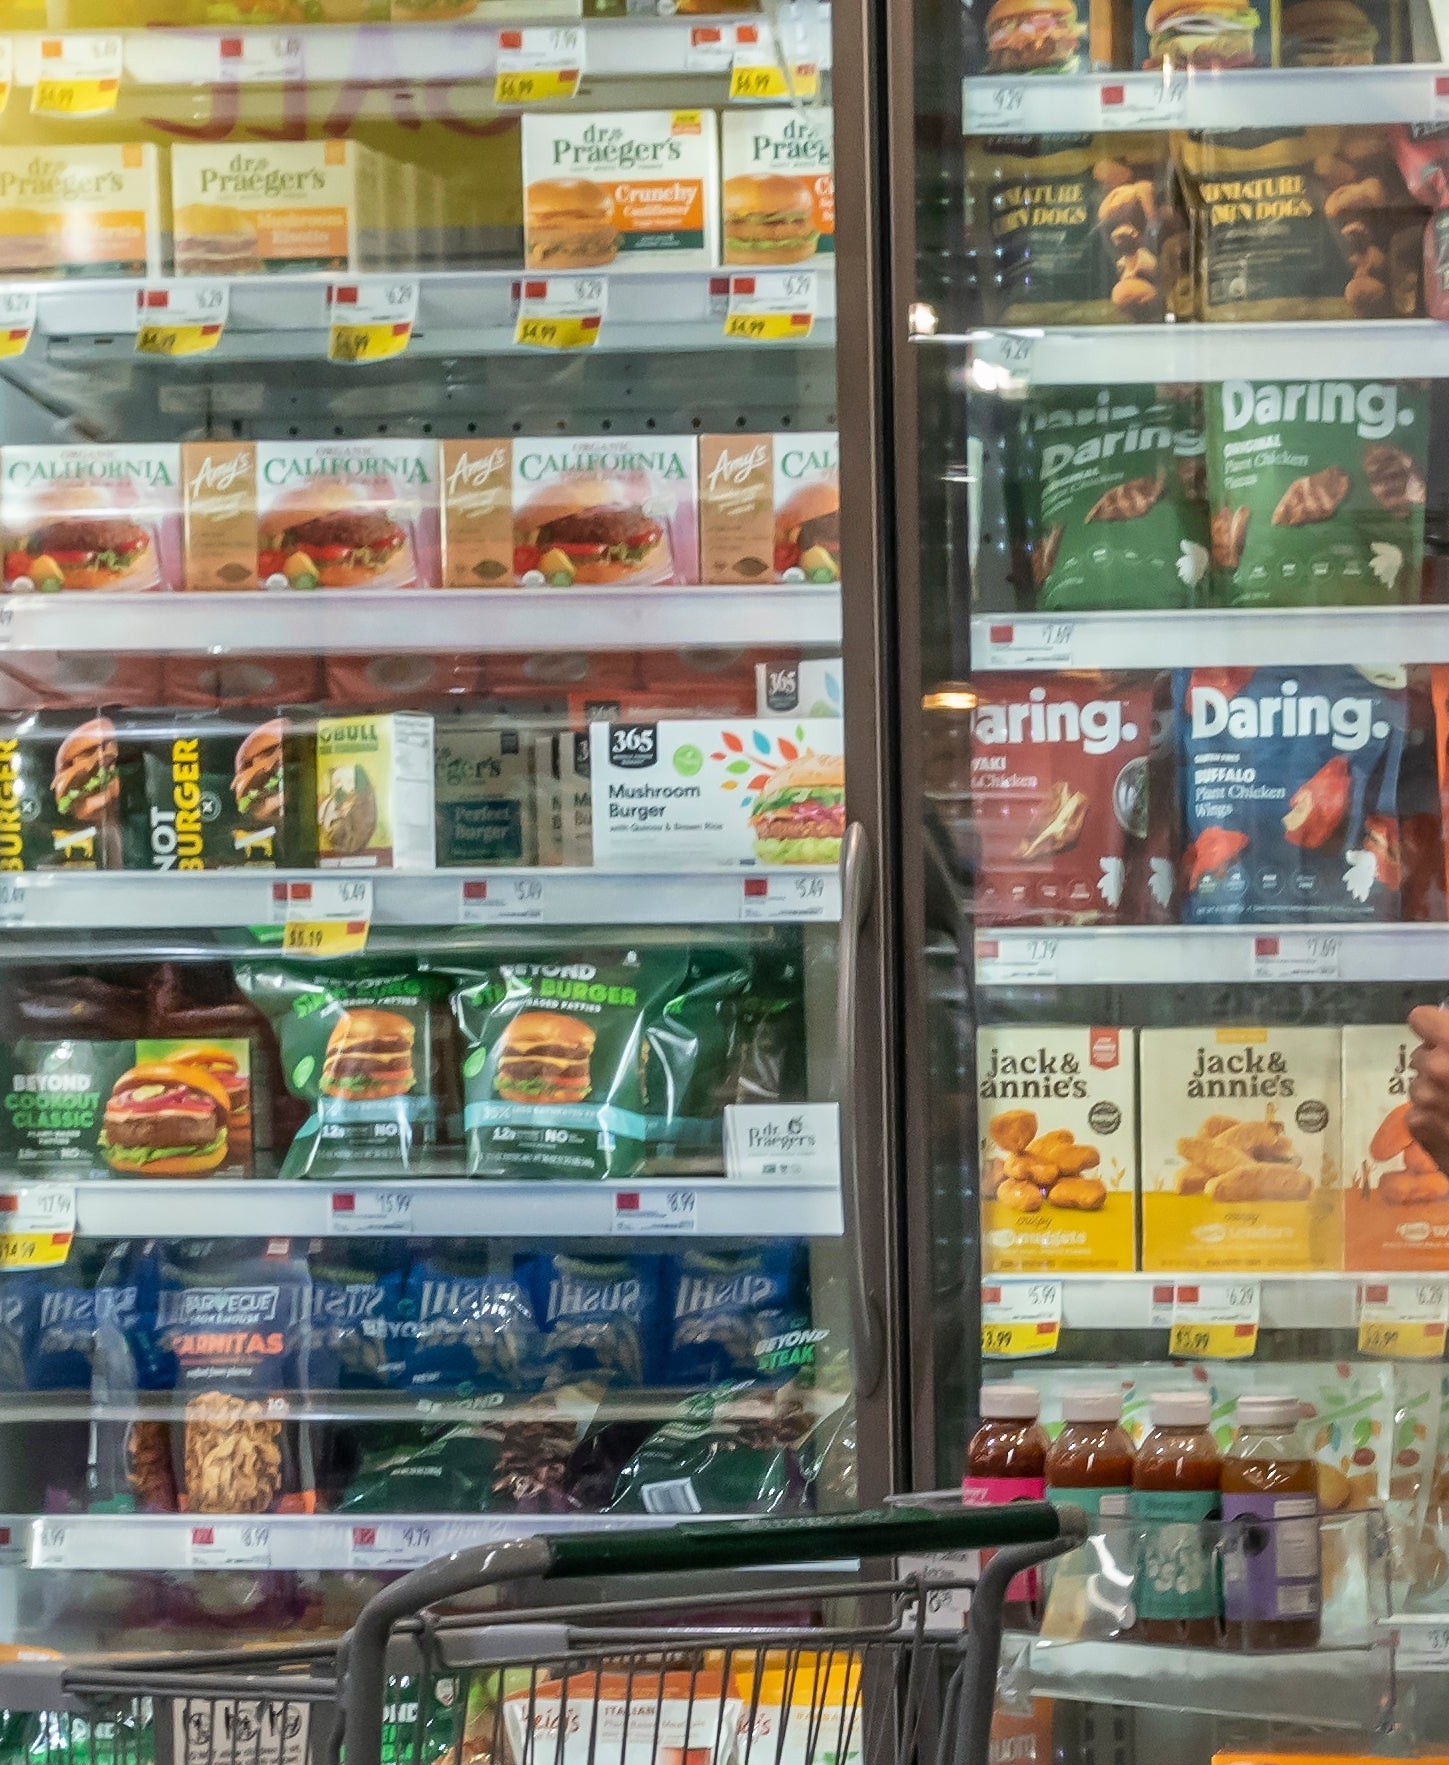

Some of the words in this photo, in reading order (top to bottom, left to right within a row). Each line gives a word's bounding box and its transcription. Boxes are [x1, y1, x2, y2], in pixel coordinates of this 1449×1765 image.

[553, 137, 681, 169] Praeger's
[0, 169, 124, 201] Praeger's
[200, 168, 325, 201] Praeger's
[615, 182, 698, 205] Crunchy
[8, 461, 173, 487] CALIFORNIA
[189, 451, 251, 497] Amy's
[263, 457, 428, 485] CALIFORNIA
[446, 446, 508, 492] Amy's
[519, 453, 688, 482] CALIFORNIA
[707, 443, 769, 489] Amy's
[972, 686, 1140, 755] aring.
[1190, 679, 1392, 751] Daring.
[612, 728, 654, 755] 365
[1194, 766, 1257, 786] BUFFALO
[172, 737, 205, 873] BURGER
[608, 785, 701, 799] Mushroom
[1195, 786, 1226, 802] Plant
[1228, 784, 1287, 800] Chicken
[608, 802, 666, 819] Burger
[1195, 802, 1234, 820] Wings
[152, 806, 176, 872] NOT
[539, 978, 637, 1007] BURGER
[986, 1047, 1083, 1077] jack&
[1192, 1046, 1289, 1077] jack&
[13, 1074, 91, 1091] BEYOND
[979, 1071, 1090, 1100] annie's
[1186, 1070, 1298, 1100] annie's
[5, 1093, 99, 1110] COOKOUT
[12, 1110, 94, 1128] CLASSIC
[754, 1329, 829, 1357] BEYOND
[756, 1345, 815, 1370] STEAK
